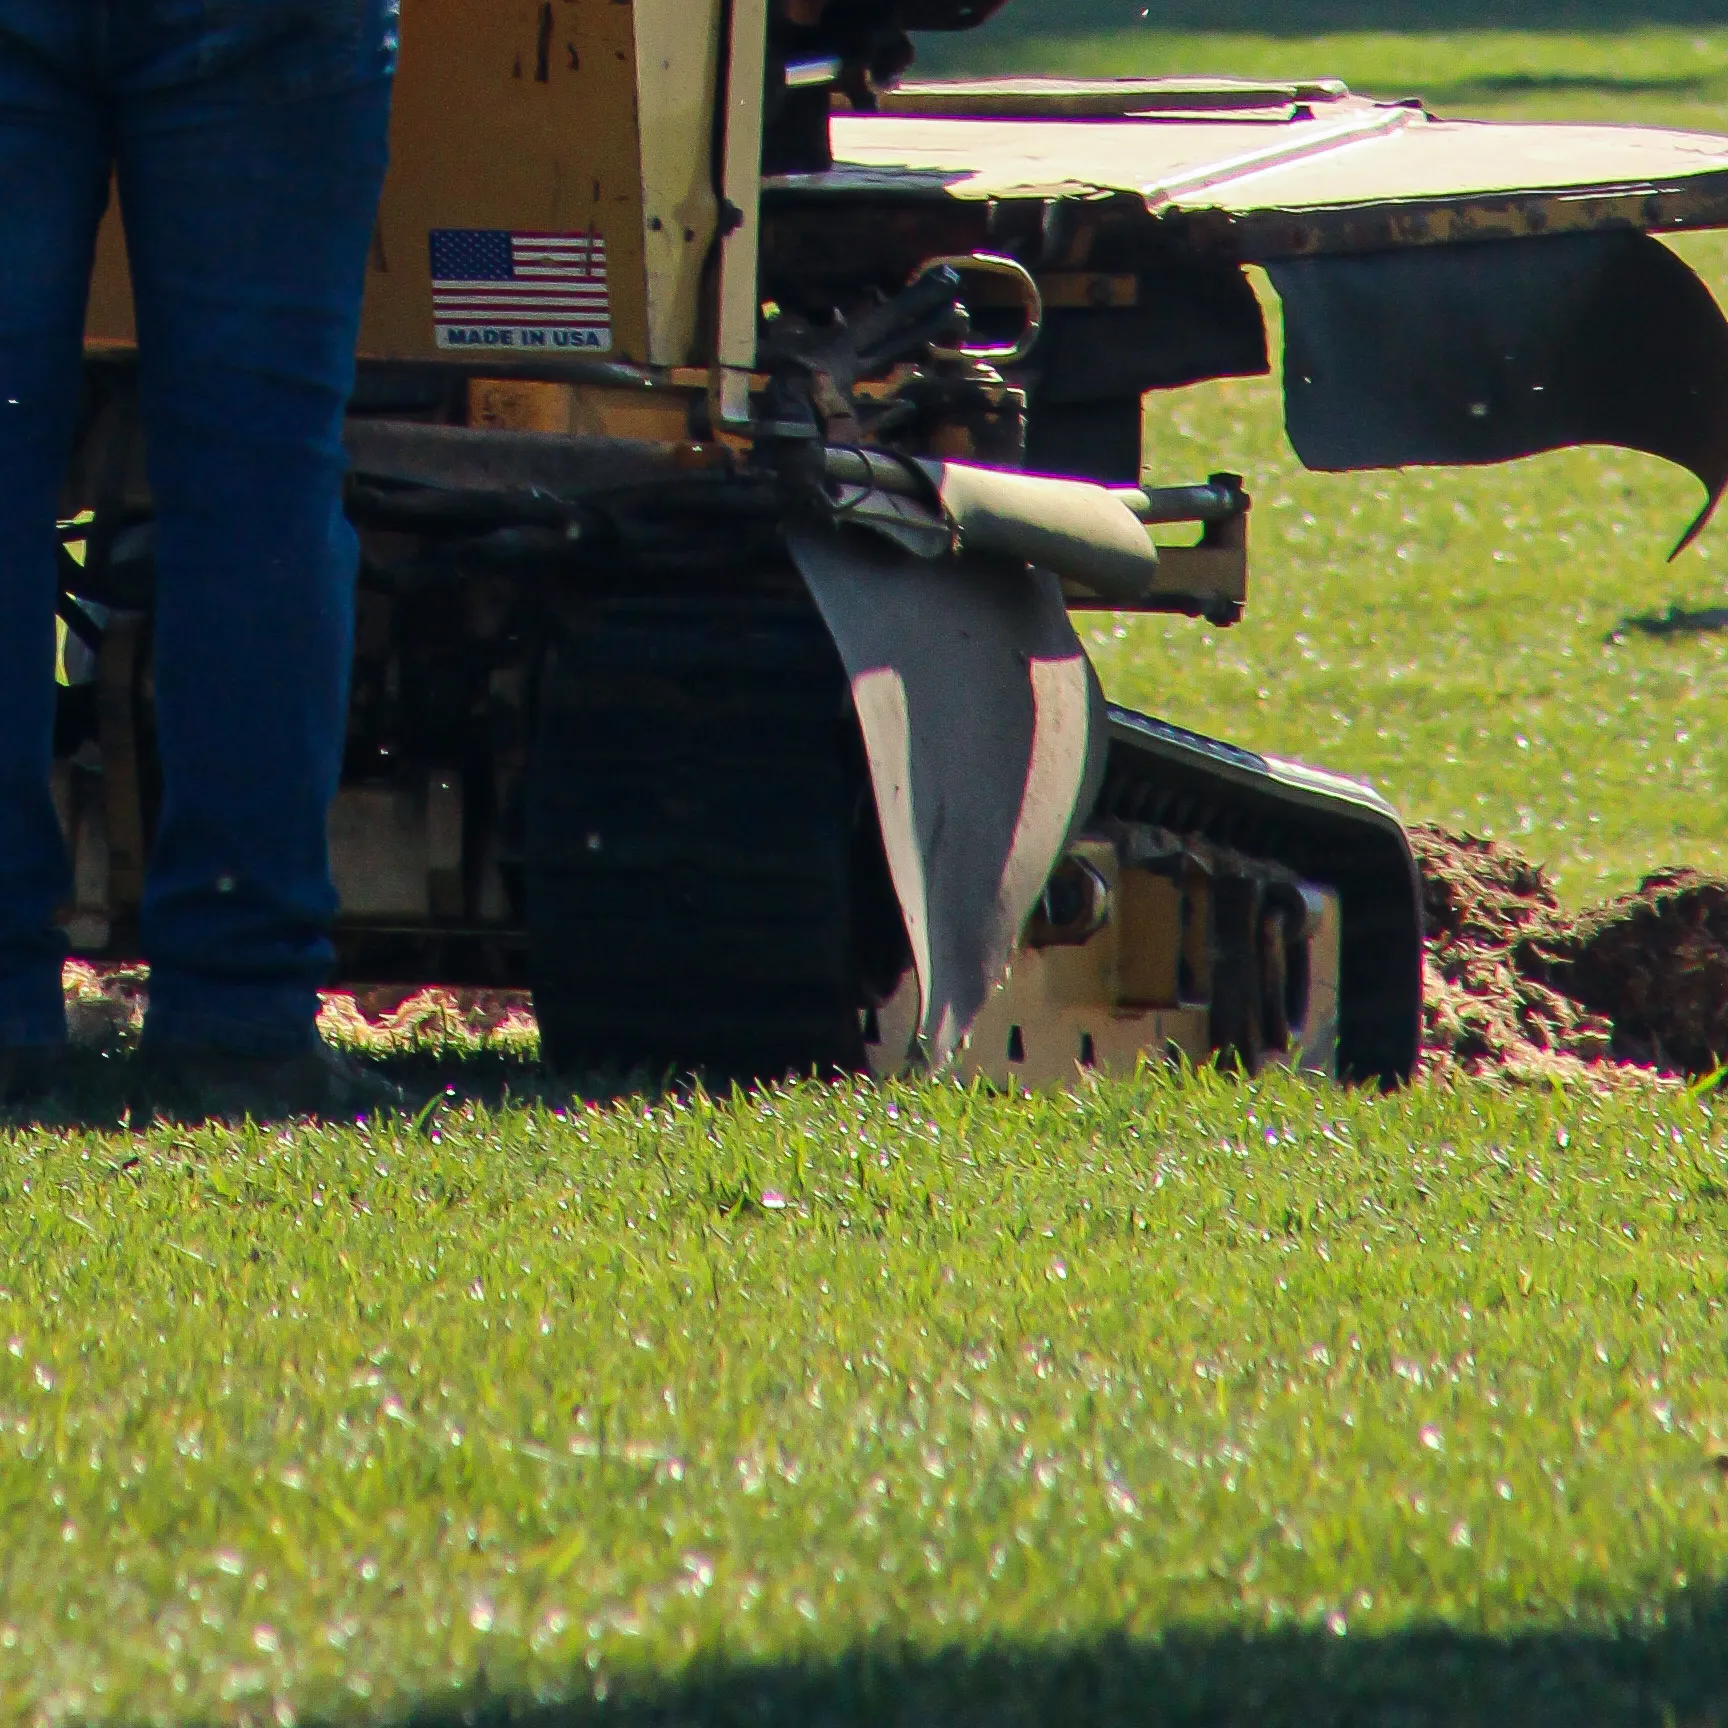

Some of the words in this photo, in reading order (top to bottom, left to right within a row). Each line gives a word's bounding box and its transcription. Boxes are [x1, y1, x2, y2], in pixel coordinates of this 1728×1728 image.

[447, 328, 514, 346] MADE
[522, 330, 544, 345] IN
[552, 330, 601, 348] USA
